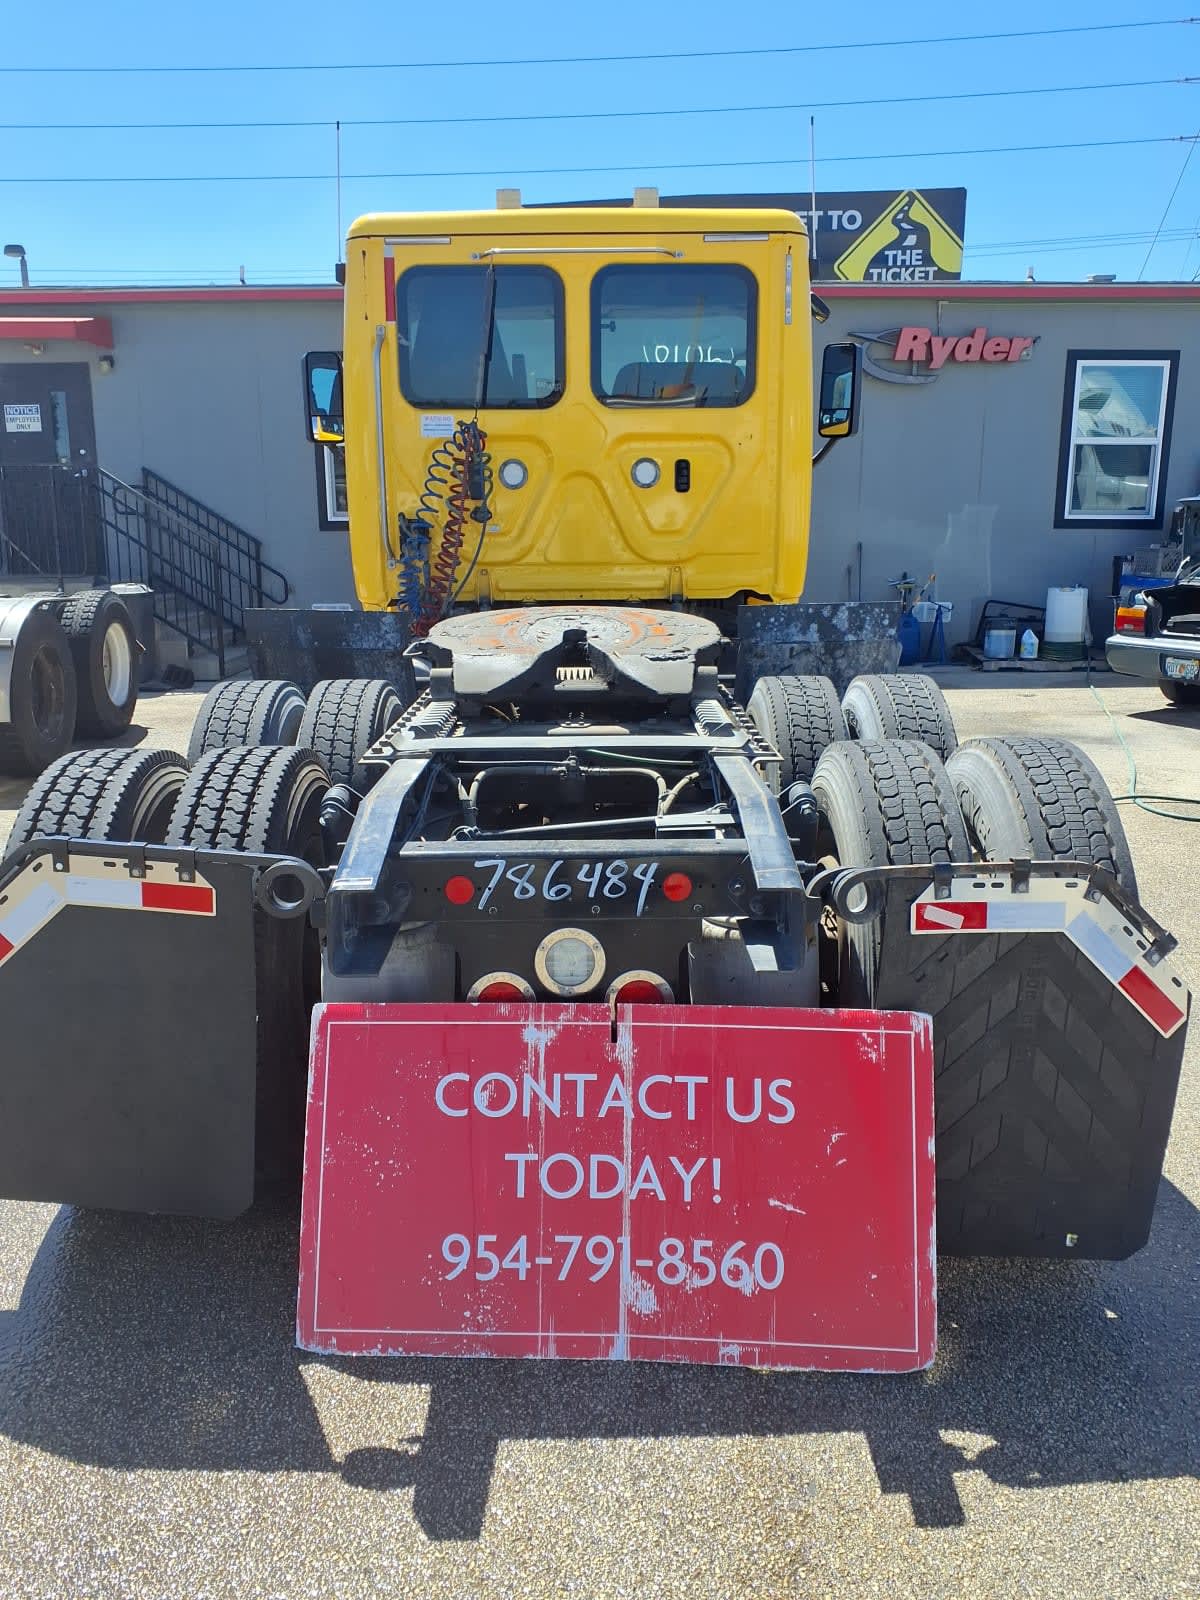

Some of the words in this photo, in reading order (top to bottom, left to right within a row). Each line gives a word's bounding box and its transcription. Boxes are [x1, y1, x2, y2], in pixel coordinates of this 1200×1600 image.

[827, 209, 862, 230] TO
[869, 266, 938, 281] TICKET
[884, 249, 923, 266] THE
[894, 326, 1034, 369] Ryder
[6, 406, 38, 415] NOTICE
[474, 859, 659, 917] 786484
[434, 1072, 708, 1121] CONTACT
[726, 1077, 796, 1124] US
[505, 1152, 721, 1204] TODAY!
[441, 1233, 785, 1290] 954-791-8560
